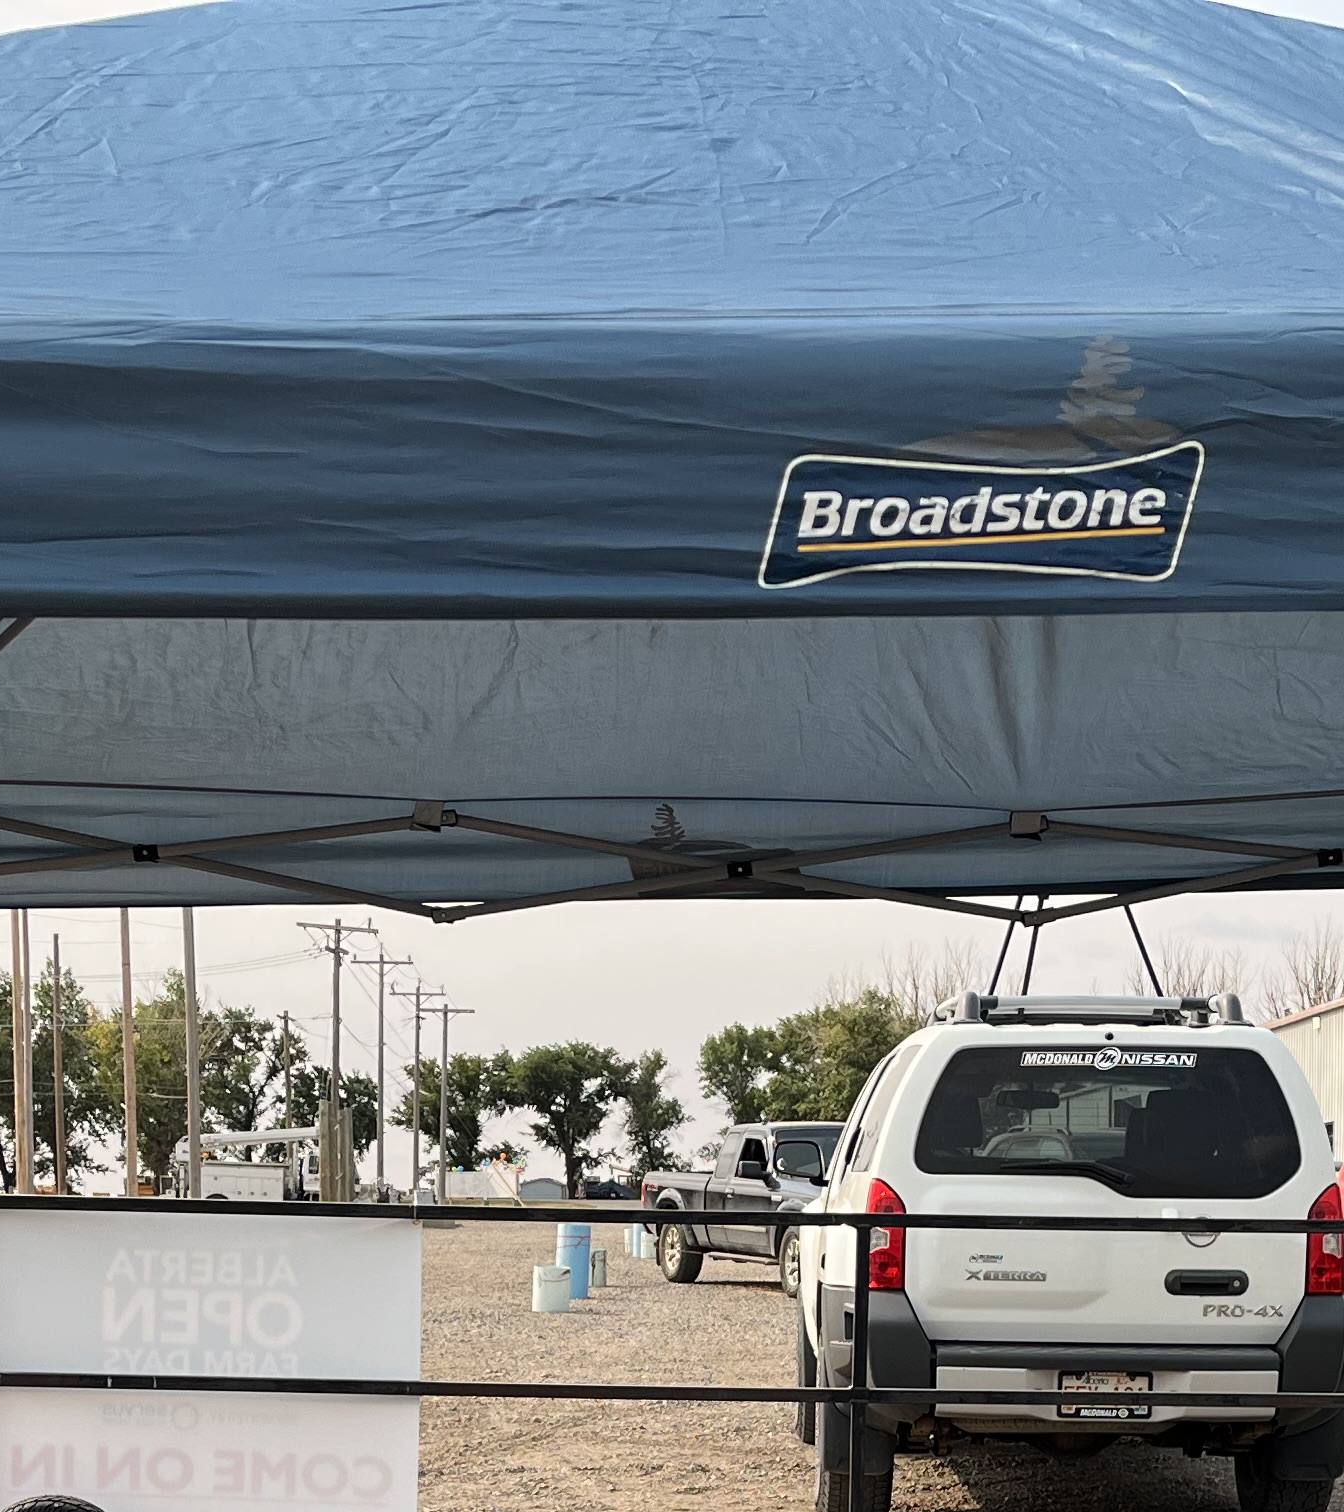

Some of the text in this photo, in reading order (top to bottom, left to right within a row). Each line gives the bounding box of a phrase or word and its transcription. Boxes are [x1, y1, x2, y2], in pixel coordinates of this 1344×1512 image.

[797, 485, 1166, 539] Broadstone
[1023, 1052, 1195, 1066] MCDONALD NISSAN
[965, 1268, 1047, 1281] XTERRA
[1202, 1304, 1284, 1318] PRO-4X
